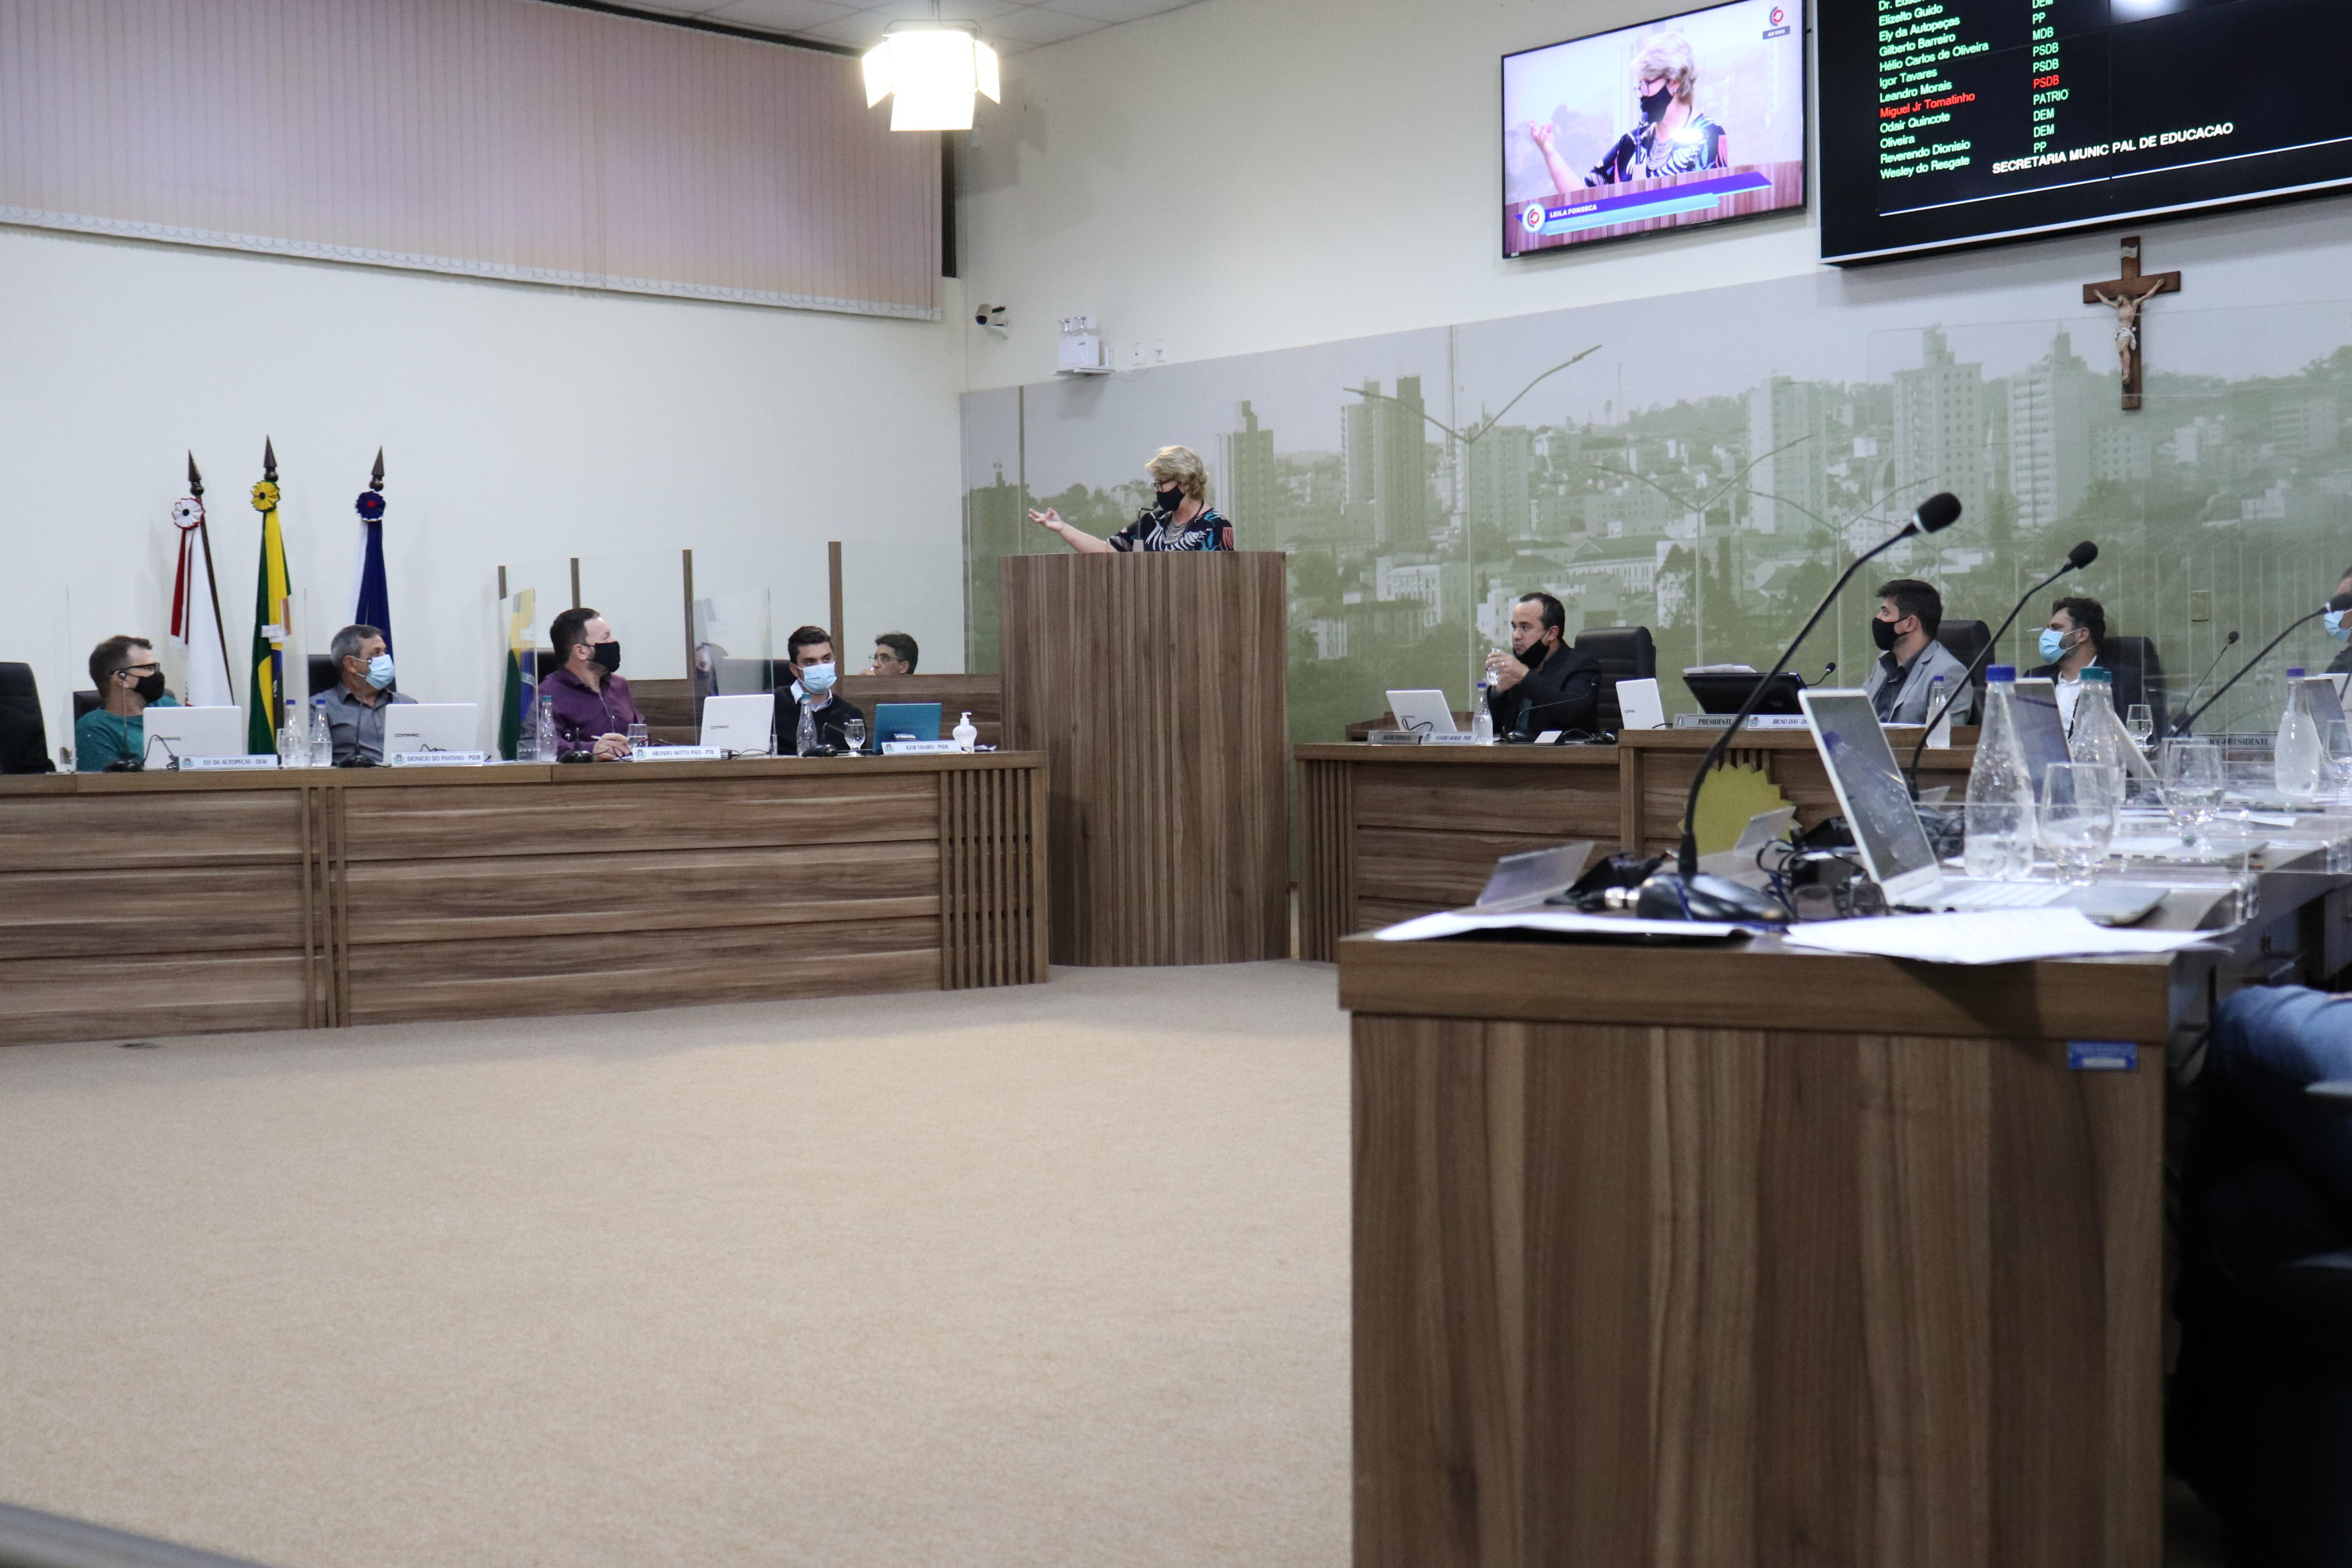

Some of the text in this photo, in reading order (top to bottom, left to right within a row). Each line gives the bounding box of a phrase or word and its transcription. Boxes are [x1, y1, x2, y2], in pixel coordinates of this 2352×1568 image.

[1879, 0, 1893, 11] Dr.
[1914, 4, 1943, 18] Guido
[2032, 12, 2045, 24] PP
[1879, 17, 1960, 43] Ely da Autopeças
[2033, 26, 2054, 41] MDB
[1879, 33, 1956, 57] Gilberto Barreiro
[2033, 42, 2059, 57] PSDB
[1879, 42, 1989, 72] Hélio Carlos de Oliveira
[2033, 58, 2059, 74] PSDB
[1879, 69, 1938, 89] Igor Tavares
[2033, 74, 2060, 89] PSDB
[1879, 80, 1952, 103] Leandro Morais
[2033, 89, 2070, 105] PATRIO
[1879, 92, 1976, 119] Miguel Jr Tomatinho
[2034, 107, 2055, 122] DEM
[1879, 112, 1951, 133] Odair Quincote
[2034, 123, 2055, 138] DEM
[1880, 134, 1915, 149] Oliveira
[1992, 151, 2067, 174] SECRETARIA
[2139, 135, 2158, 149] DE
[2160, 122, 2233, 145] EDUCACAO
[2034, 141, 2047, 153] PP
[1880, 147, 1930, 164] Reverendo
[1880, 156, 1970, 179] Wesley do Resgate
[1550, 204, 1597, 218] LEILA FONSECA
[2209, 737, 2269, 746] ICE-PRESIDENTE
